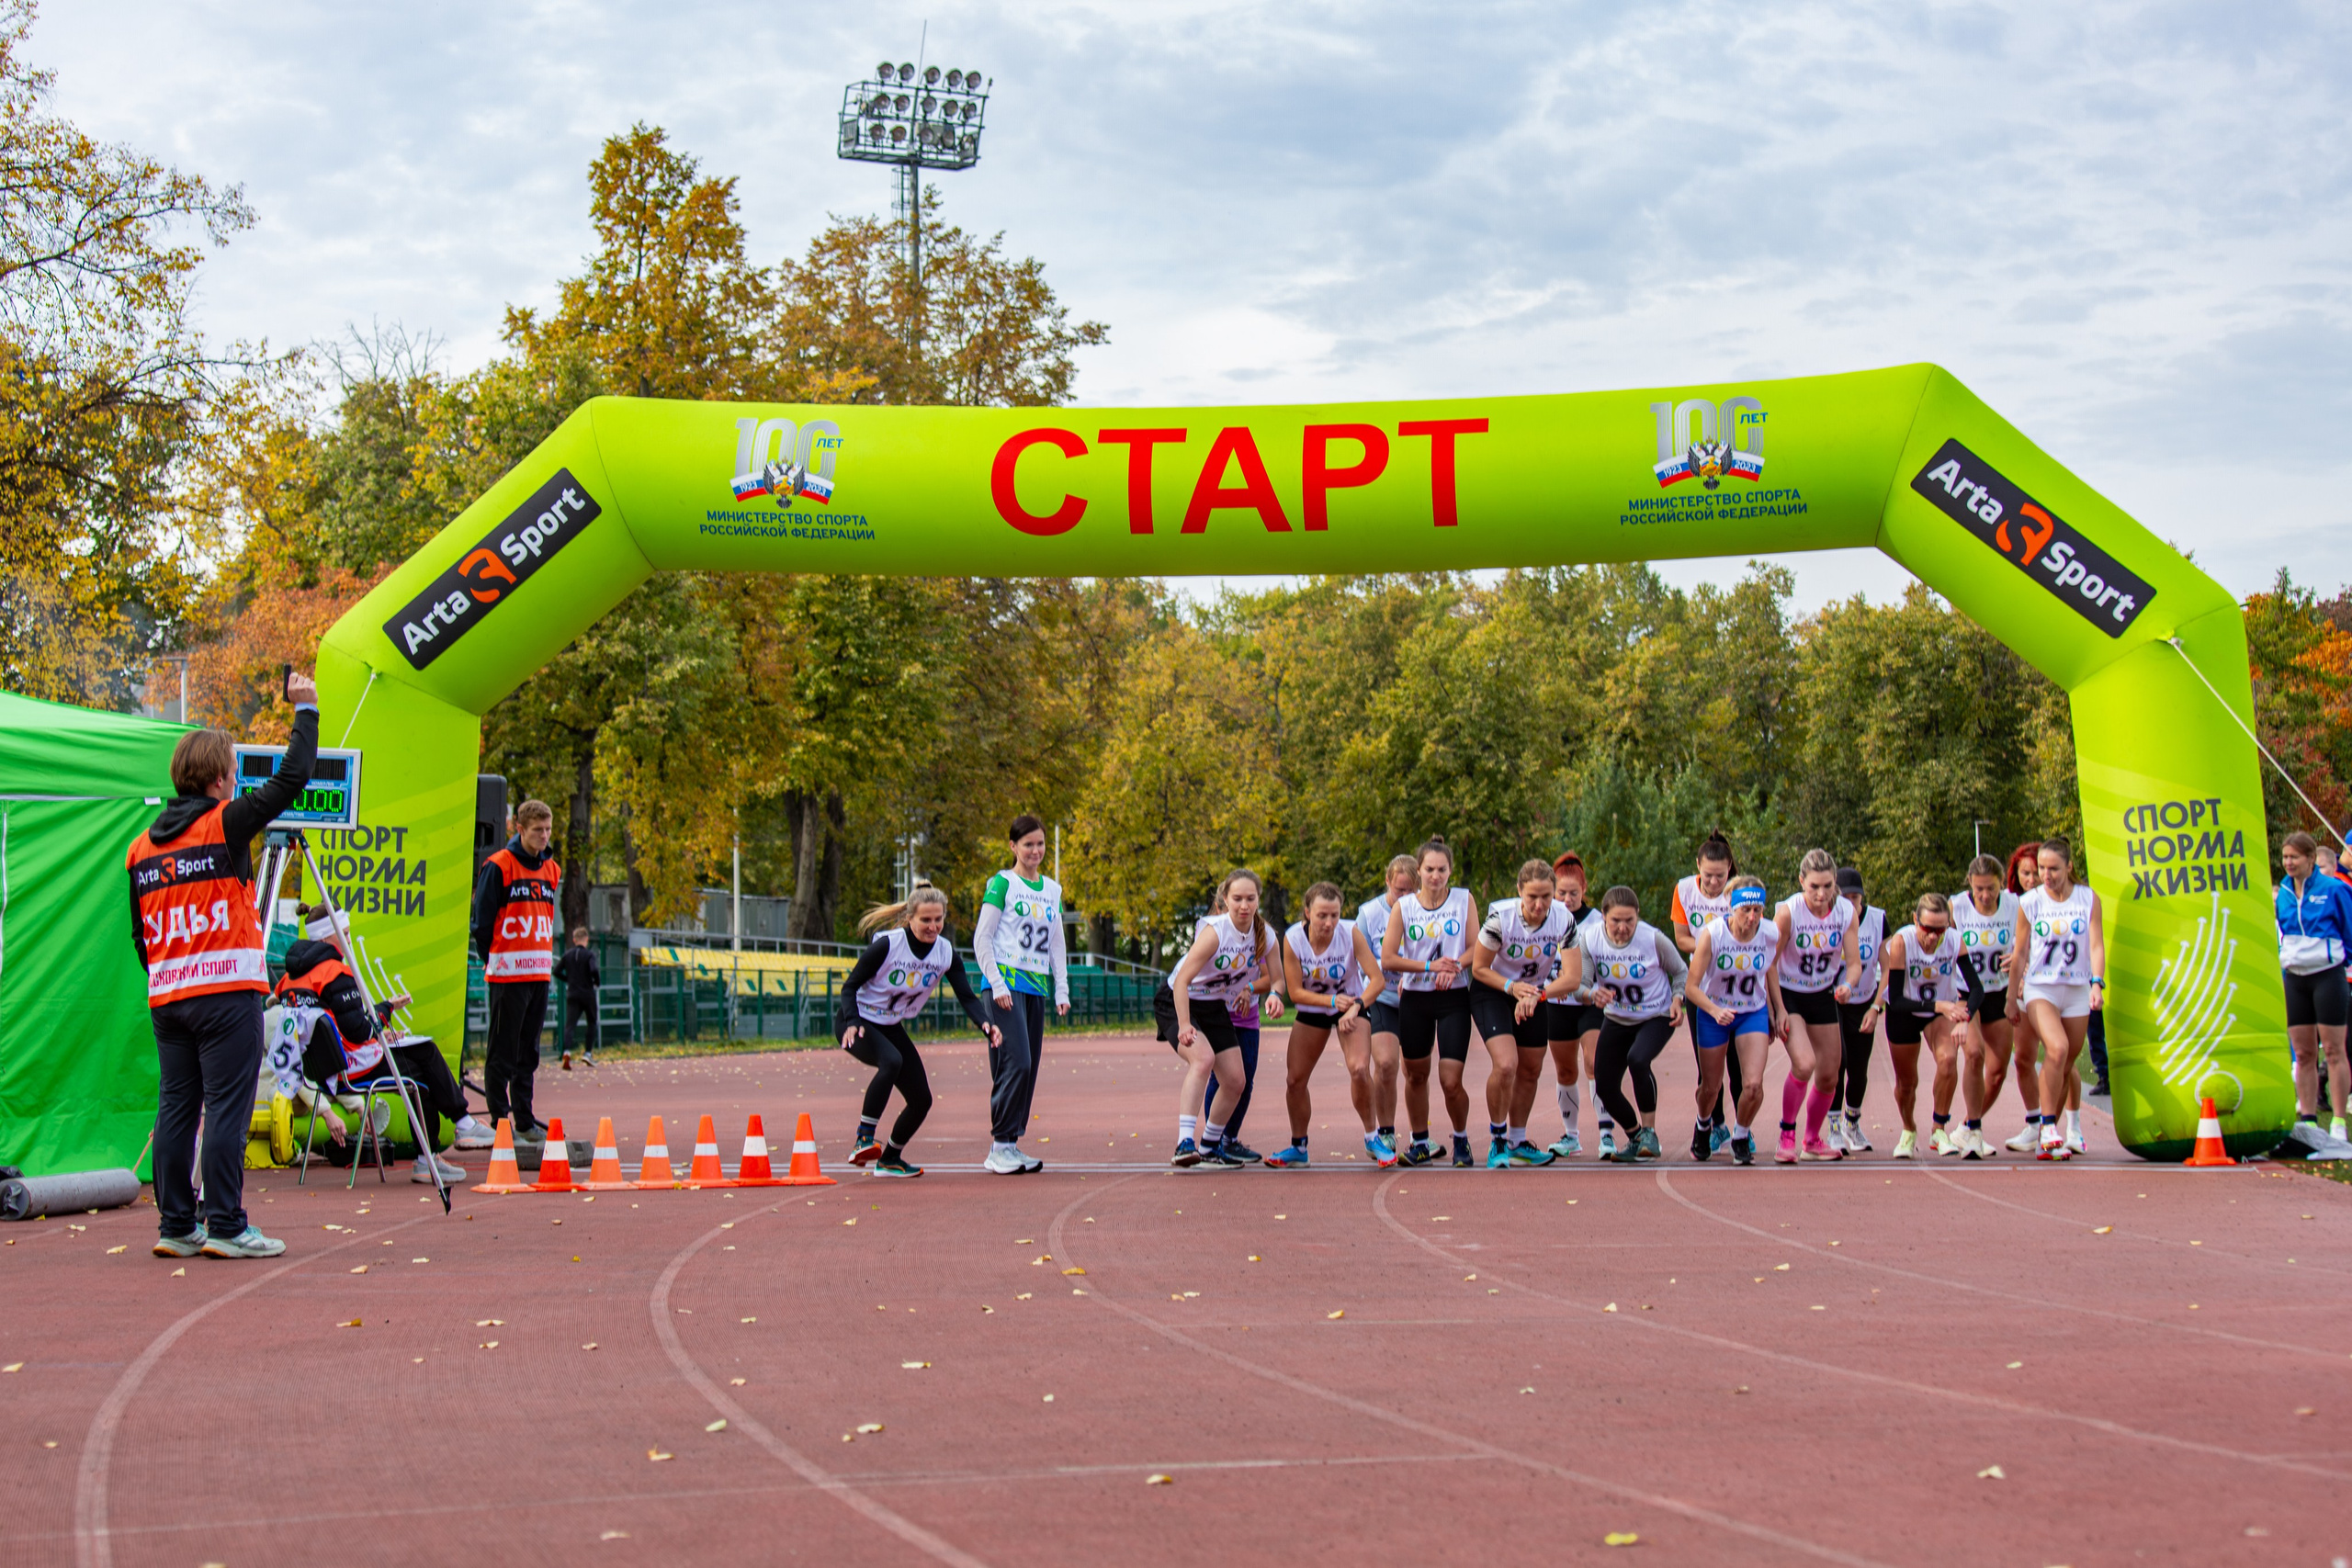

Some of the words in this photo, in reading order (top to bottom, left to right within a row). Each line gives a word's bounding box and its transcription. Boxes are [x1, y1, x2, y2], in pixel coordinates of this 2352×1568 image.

[1739, 412, 1769, 424] ЛЕТ
[816, 436, 844, 449] ЛЕТ
[990, 417, 1489, 537] СТАРТ
[1663, 463, 1683, 479] 1923
[1734, 459, 1757, 473] 2023
[739, 479, 759, 494] 1923
[805, 479, 827, 497] 2023
[1628, 492, 1742, 512] МИНИСТЕРСТВО
[1746, 488, 1801, 504] СПОРТА
[707, 510, 812, 525] МИНИСТЕРСТВО
[816, 513, 868, 527] СПОРТА
[1620, 508, 1714, 526] РОССИЙСКОЙ
[1718, 502, 1808, 521] ФЕДЕРАЦИИ
[699, 523, 788, 538] РОССИЙСКОЙ
[791, 526, 876, 542] ФЕДЕРАЦИИ
[1927, 458, 2004, 525] Arta
[2041, 541, 2136, 623] Sport
[402, 590, 471, 656] Arta
[500, 487, 586, 567] Sport
[2123, 798, 2222, 834] СПОРТ
[320, 824, 409, 853] СПОРТ
[2127, 830, 2245, 867] НОРМА
[139, 868, 160, 887] Arta
[176, 855, 215, 876] Sport
[319, 854, 427, 886] НОРМА
[2132, 863, 2249, 900] ЖИЗНИ
[510, 886, 530, 898] Arta
[143, 899, 231, 947] УДЬЯ
[1796, 922, 1843, 932] VMARAFONE
[1962, 920, 2011, 930] VMARAFONE
[1018, 922, 1049, 954] 32
[1798, 951, 1834, 976] 85
[2043, 938, 2079, 966] 79
[202, 958, 238, 977] СПОРТ
[1722, 974, 1758, 997] 10
[1917, 981, 1938, 1002] 6
